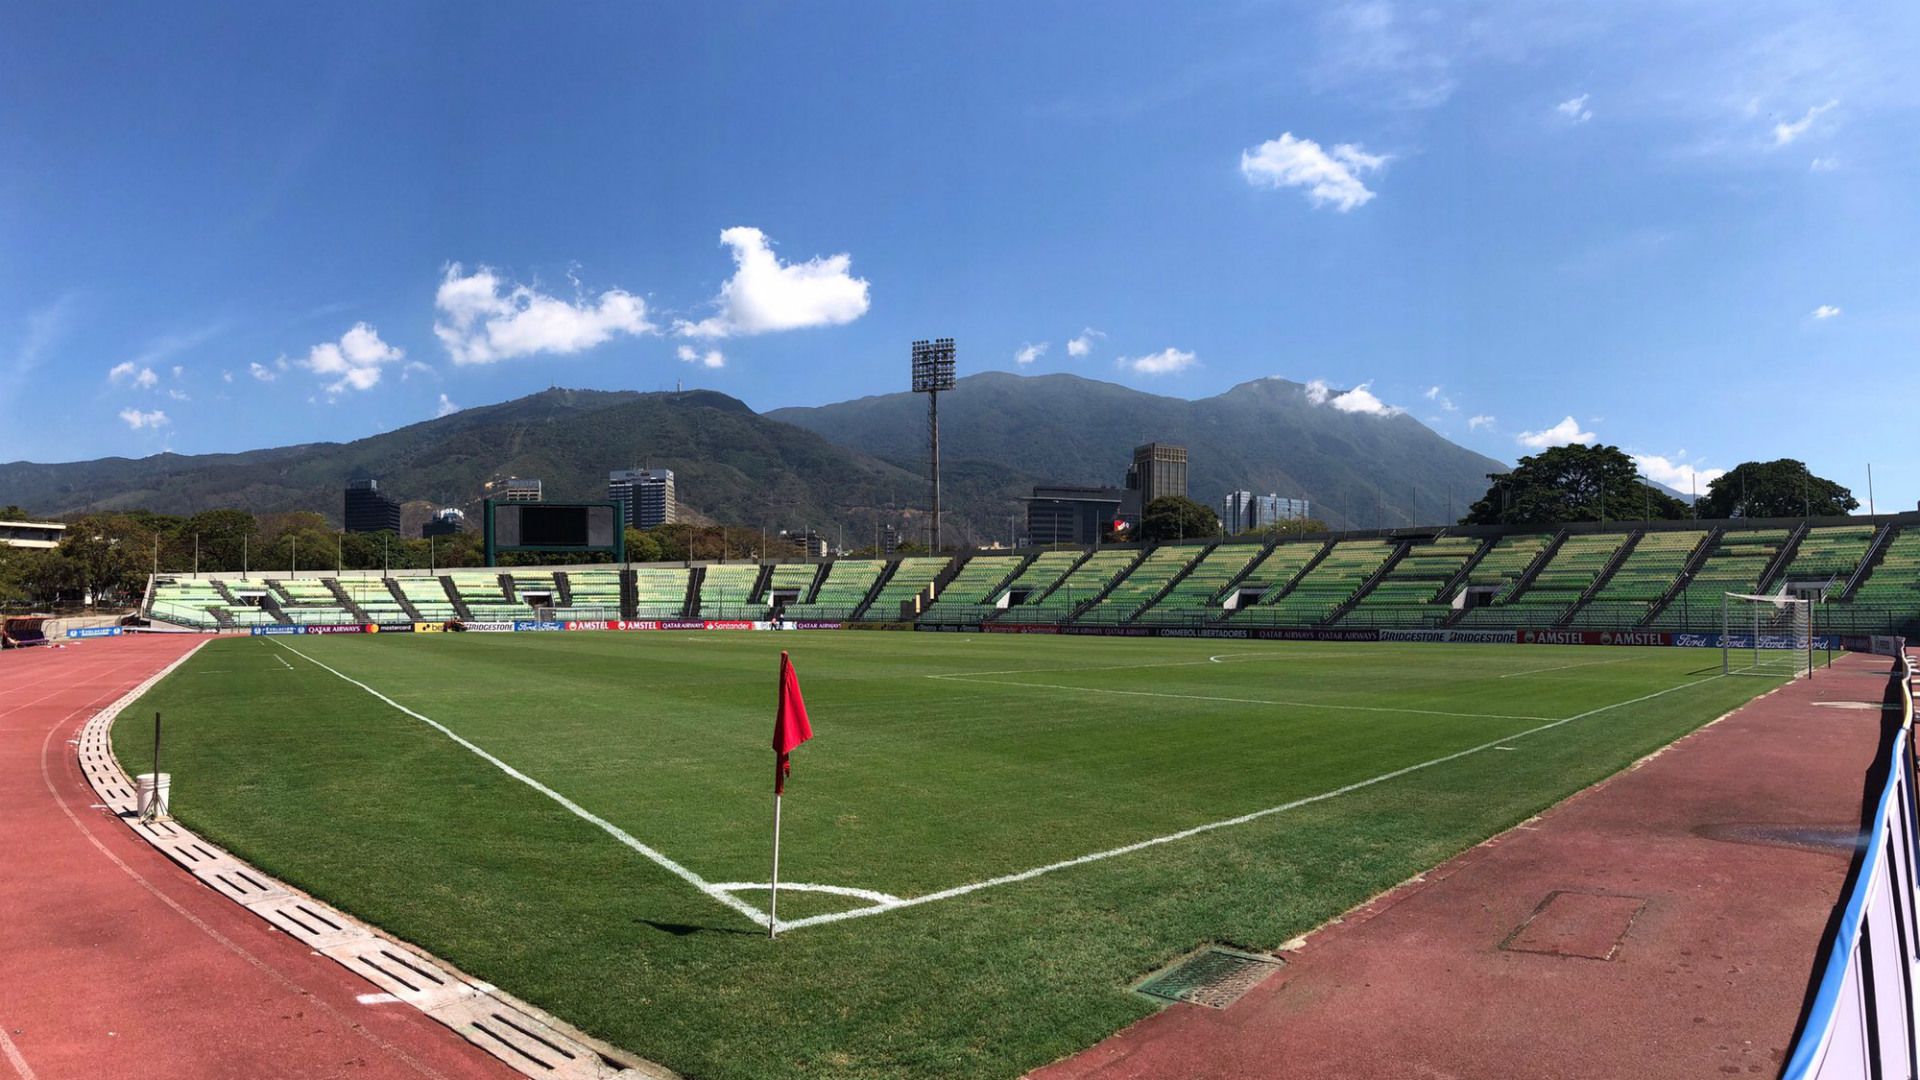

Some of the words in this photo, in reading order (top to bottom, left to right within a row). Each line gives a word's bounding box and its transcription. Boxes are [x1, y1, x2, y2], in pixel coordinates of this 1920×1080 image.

[578, 622, 609, 630] AMSTEL
[627, 622, 657, 630] AMSTEL
[1160, 629, 1196, 637] CONMEBOL
[1198, 630, 1248, 638] LIBERTADORES
[1259, 631, 1282, 639] QATAR
[1284, 631, 1314, 639] AIRWAYS
[1318, 632, 1343, 640] QATAR
[1345, 632, 1377, 640] AIRWAYS
[1380, 631, 1446, 641] BRIDGESTONE
[1449, 632, 1516, 643] BRIDGESTONE
[1537, 632, 1585, 644] AMSTEL
[1614, 633, 1665, 645] AMSTEL
[1676, 633, 1707, 647] Ford
[1715, 635, 1746, 648] Ford
[1757, 635, 1787, 649] Ford
